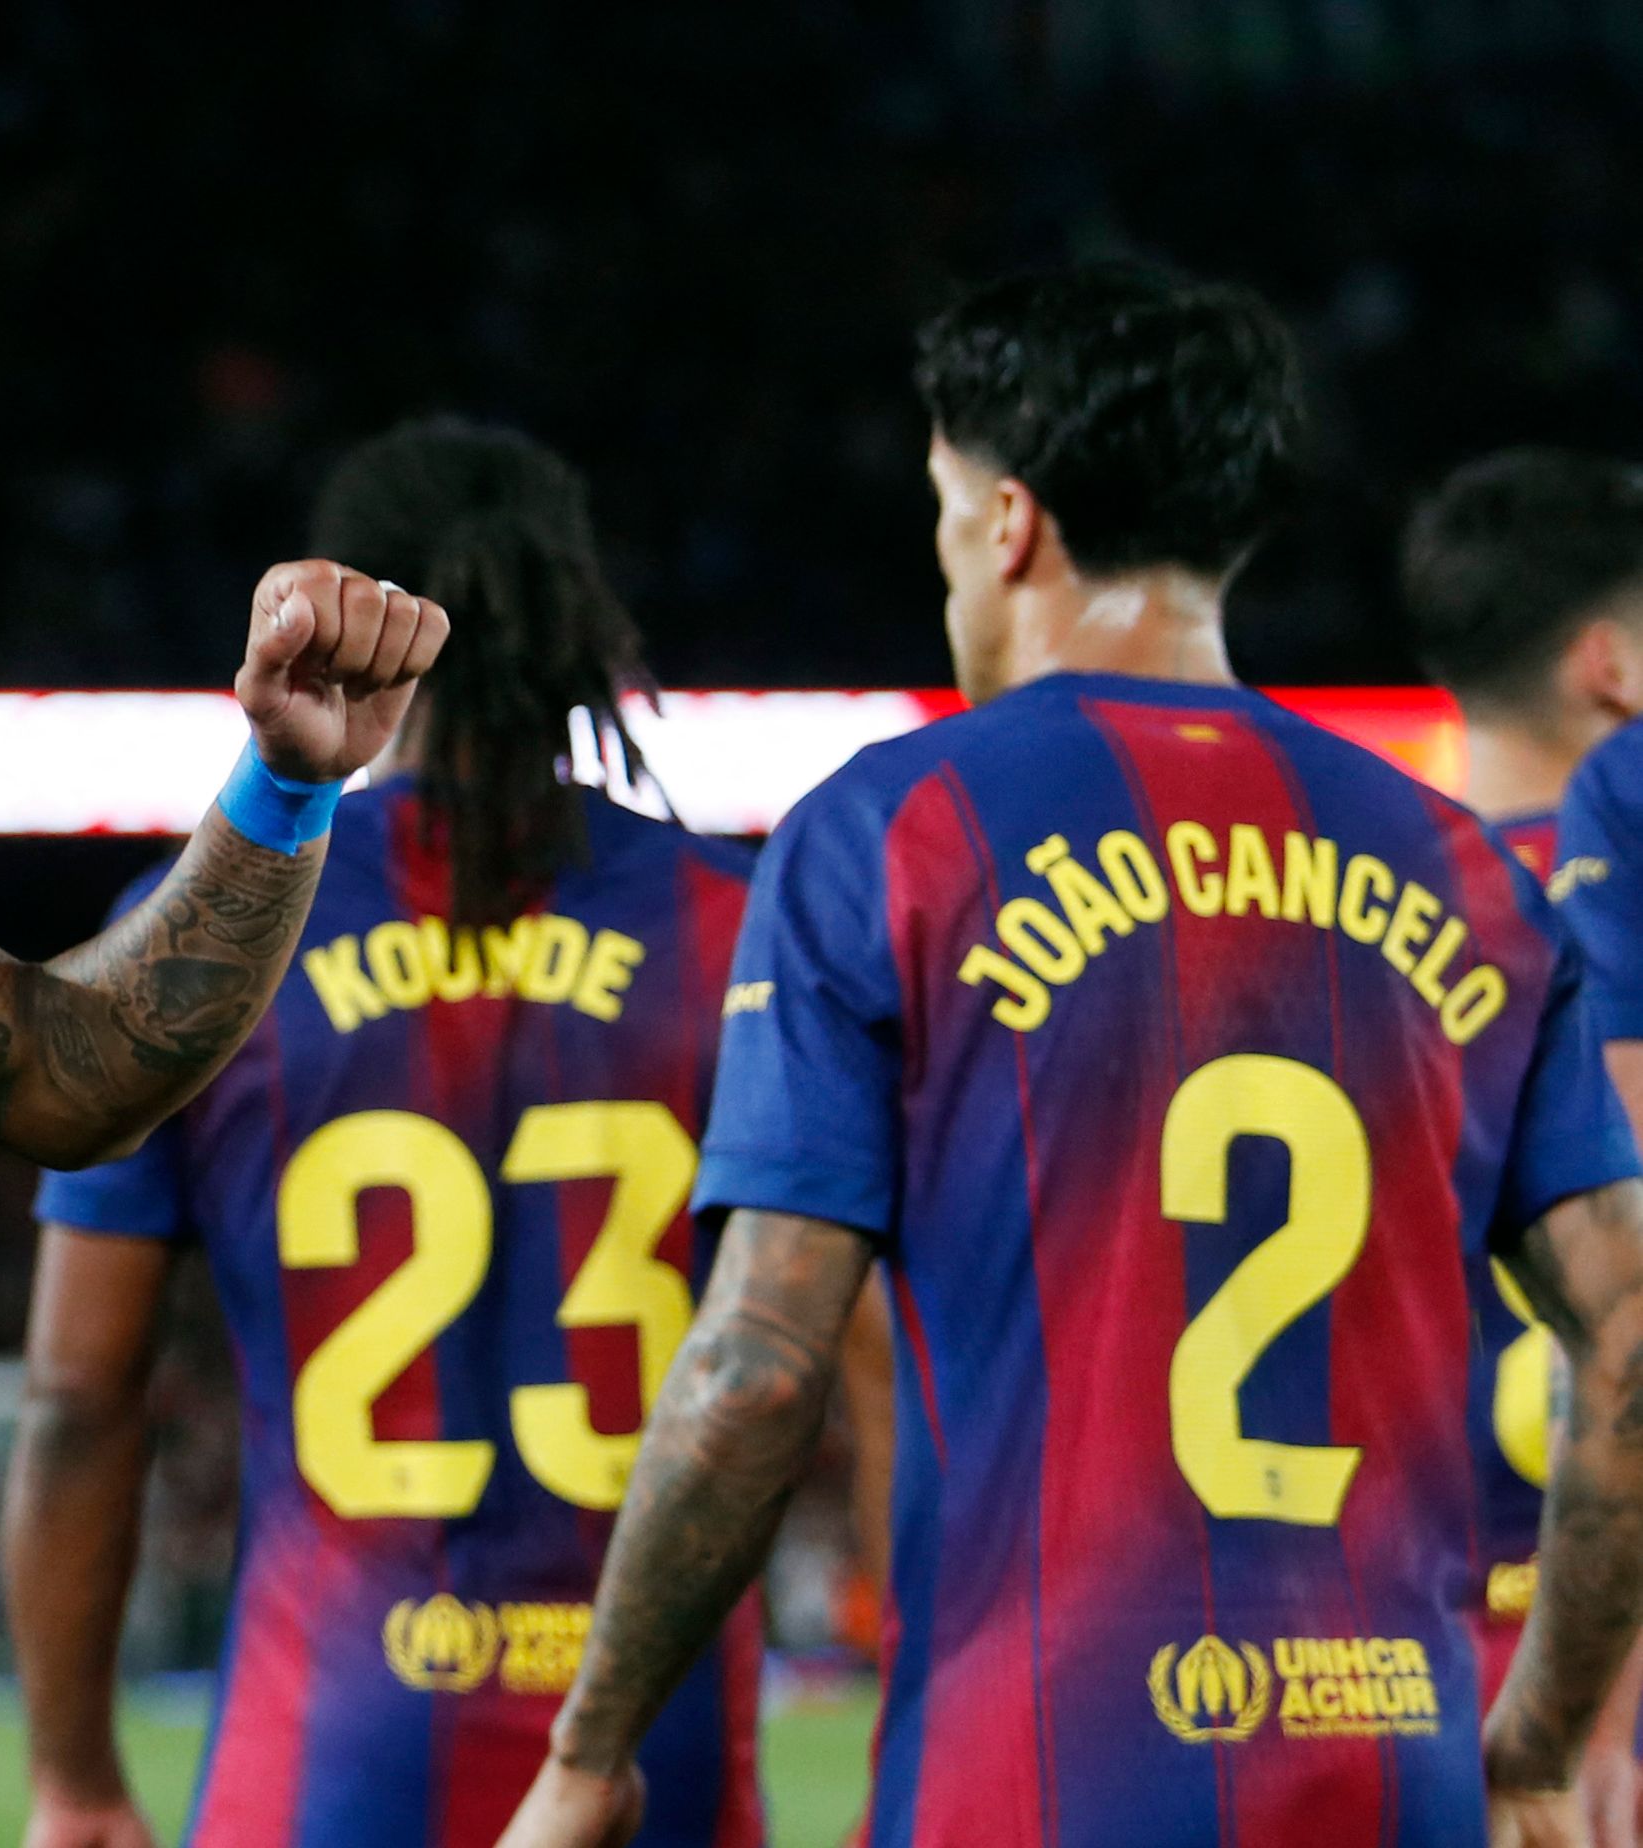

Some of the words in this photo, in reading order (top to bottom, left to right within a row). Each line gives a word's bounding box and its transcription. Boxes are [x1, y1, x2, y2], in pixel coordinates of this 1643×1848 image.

[302, 912, 646, 1034] KOUNDE
[958, 829, 1169, 1032] JOÃO
[1166, 820, 1508, 1046] CANCELO
[277, 1099, 700, 1519] 23
[1161, 1053, 1371, 1526] 2
[1273, 1637, 1431, 1678] UNHCR
[1278, 1676, 1440, 1718] ACNUR
